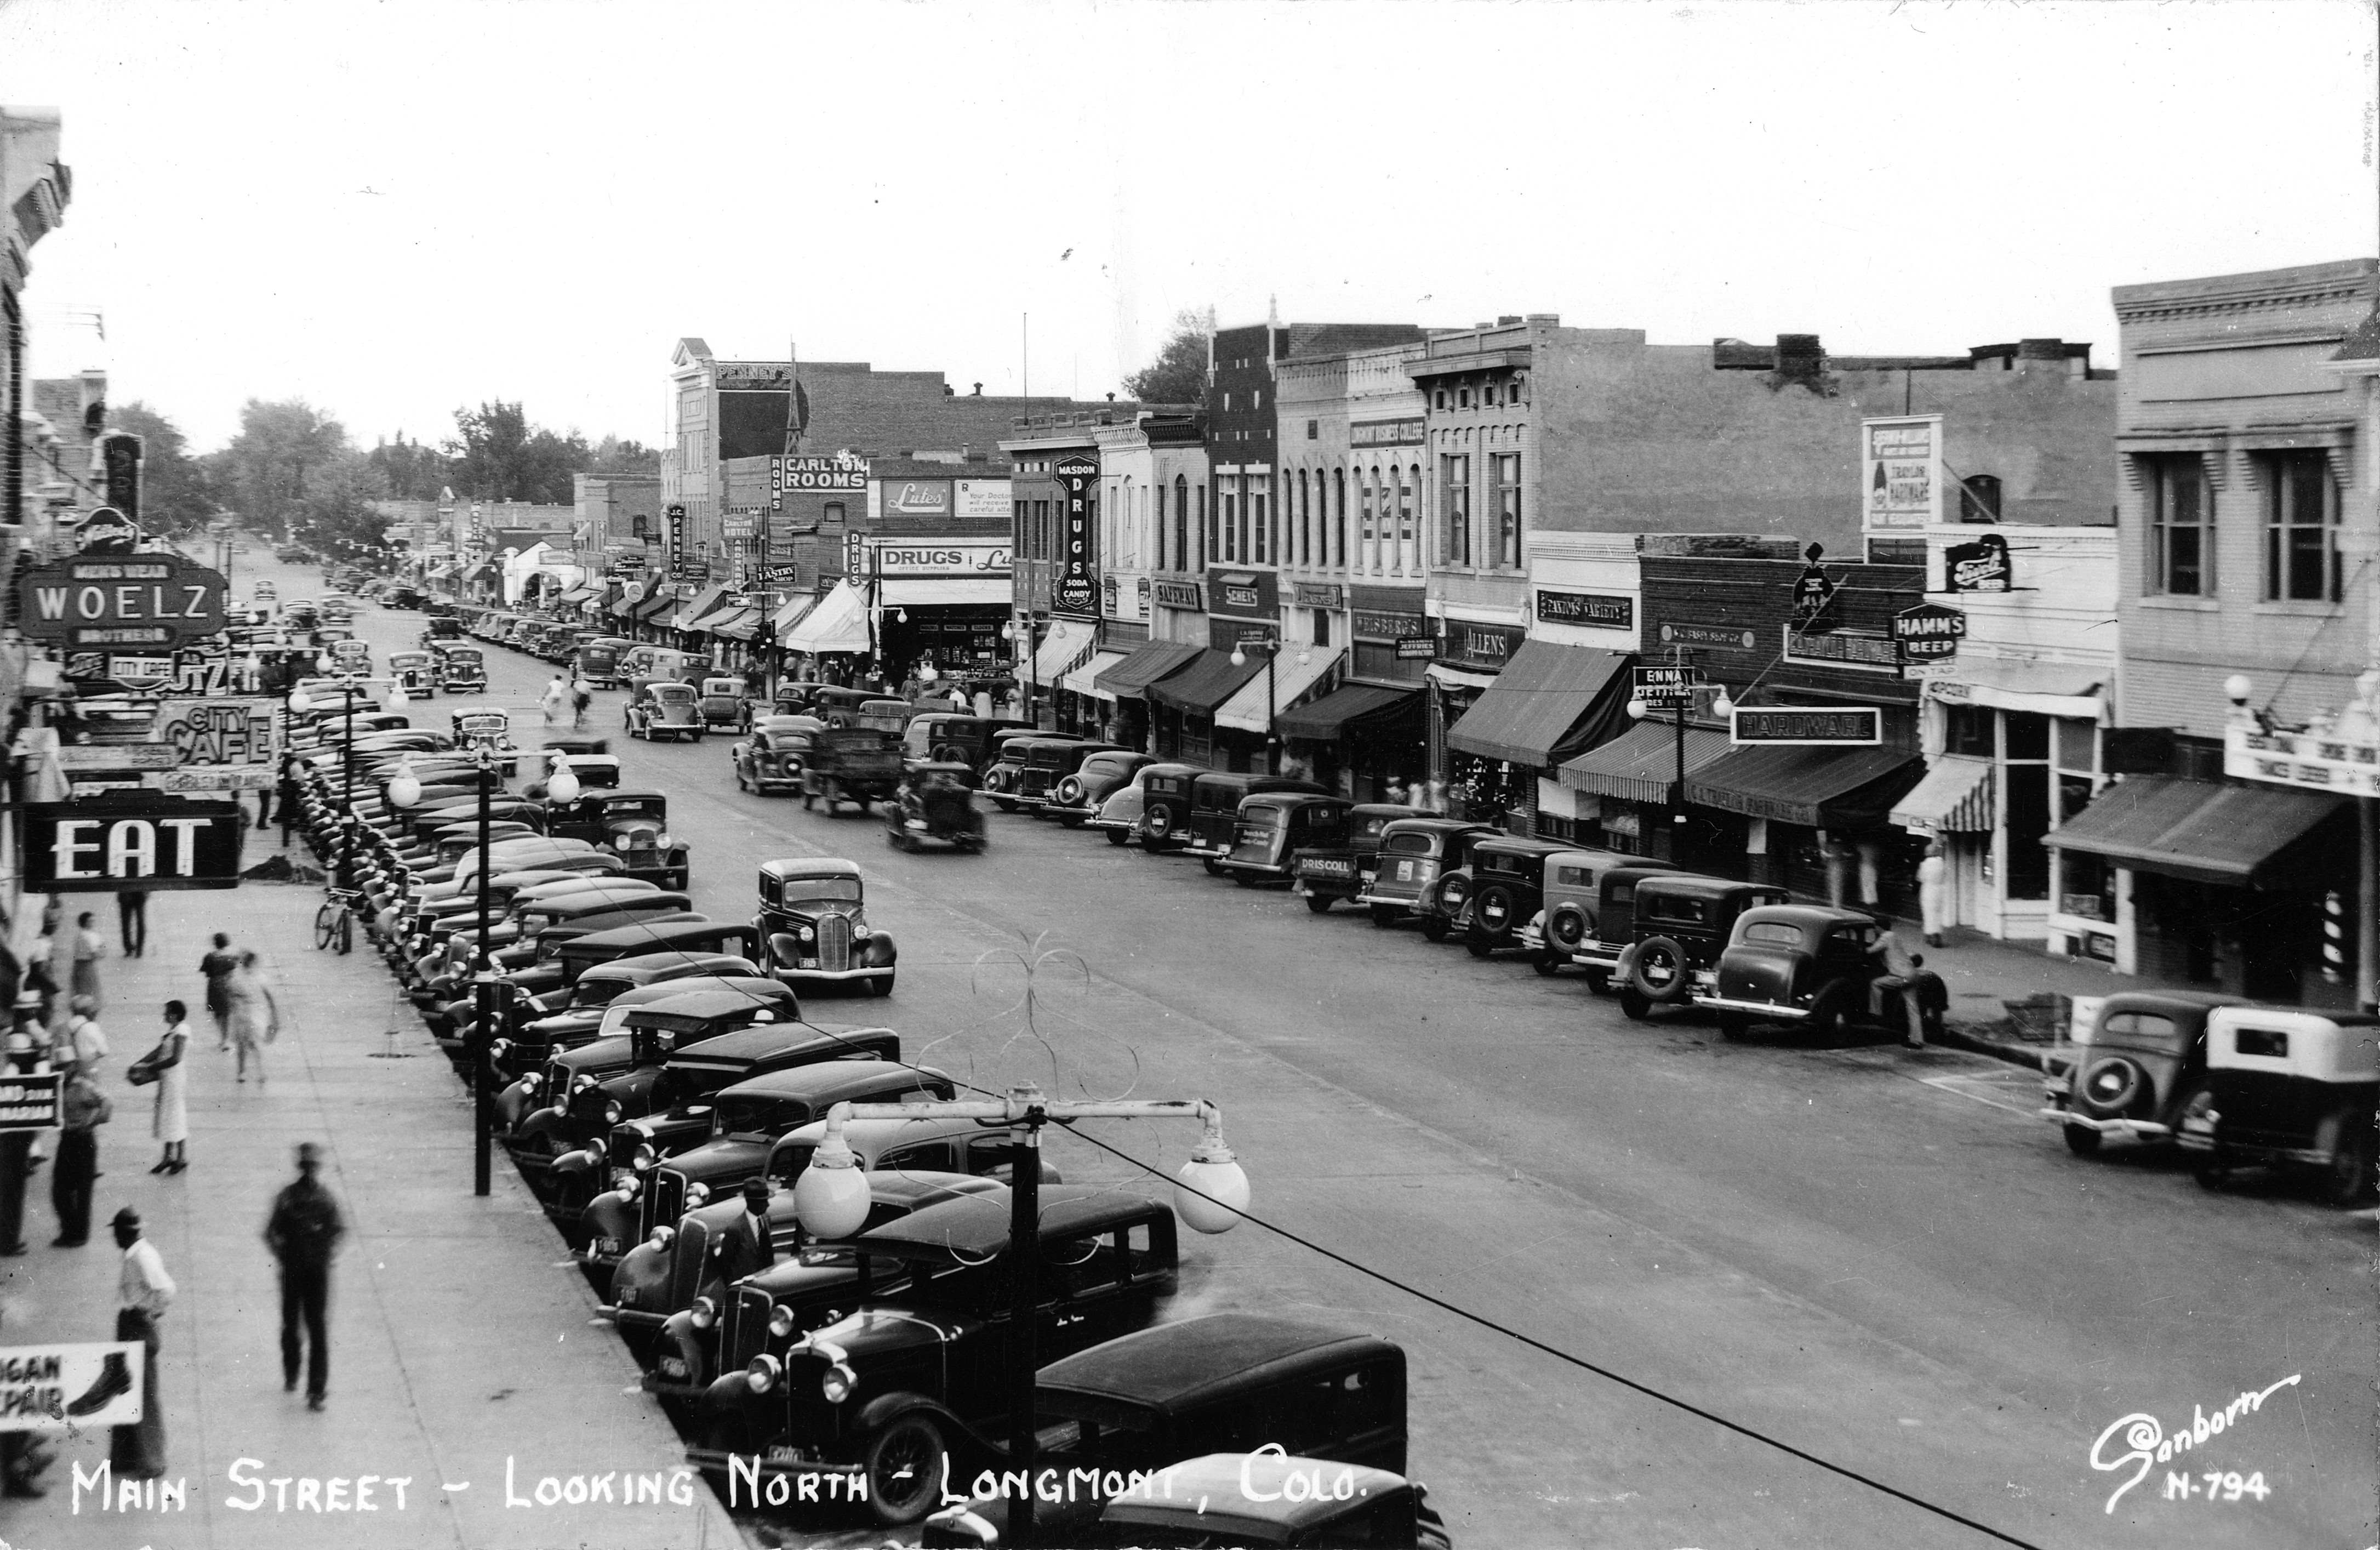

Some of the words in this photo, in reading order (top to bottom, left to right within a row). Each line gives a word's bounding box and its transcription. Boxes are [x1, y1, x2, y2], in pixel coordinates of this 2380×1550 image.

[1400, 421, 1424, 441] COLLEGE
[786, 459, 866, 471] CARLTON
[1058, 466, 1095, 475] MASDON
[772, 459, 781, 510] ROOMS
[786, 473, 865, 487] ROOMS
[724, 528, 753, 536] HOTEL
[1071, 478, 1083, 574] DRUGS
[851, 534, 860, 585] DRUGS
[884, 550, 963, 565] DRUGS
[36, 585, 208, 620] WOELZ
[1063, 590, 1091, 598] CANDY
[1157, 584, 1195, 606] SAFEWAY
[1466, 622, 1505, 658] ALLEN'S
[1647, 670, 1682, 682] ENNA
[187, 706, 251, 732] CITY
[1742, 715, 1871, 737] HARDWARE
[166, 716, 271, 765] CAFE
[50, 819, 213, 879] EAT
[1302, 858, 1349, 872] DRISCOLL
